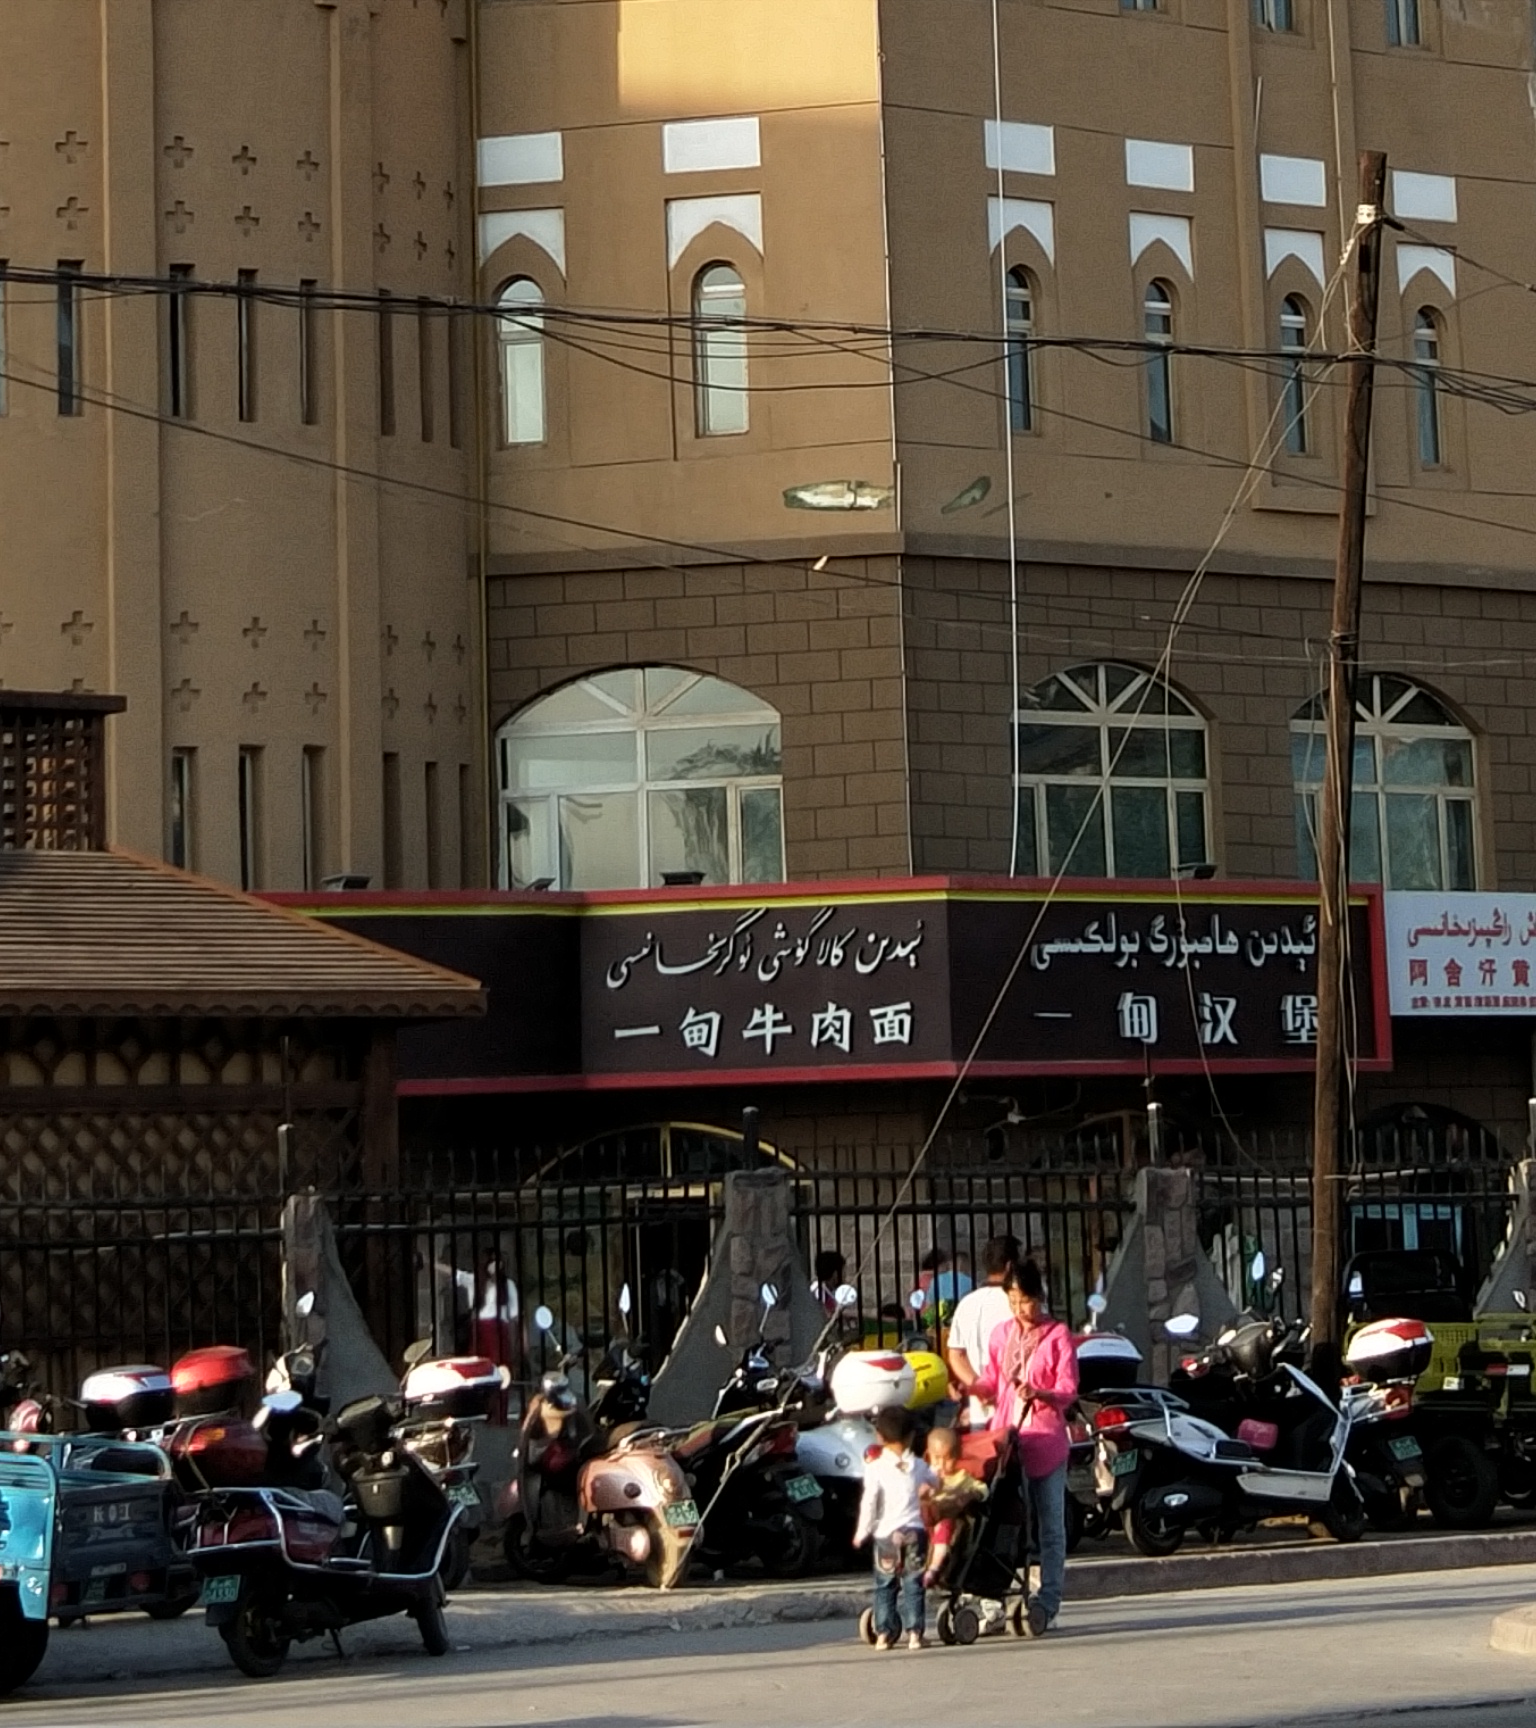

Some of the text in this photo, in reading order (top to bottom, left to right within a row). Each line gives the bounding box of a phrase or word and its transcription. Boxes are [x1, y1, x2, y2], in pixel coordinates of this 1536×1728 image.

[613, 1000, 913, 1057] 一甸牛肉面
[1033, 991, 1319, 1046] 一甸汉堡
